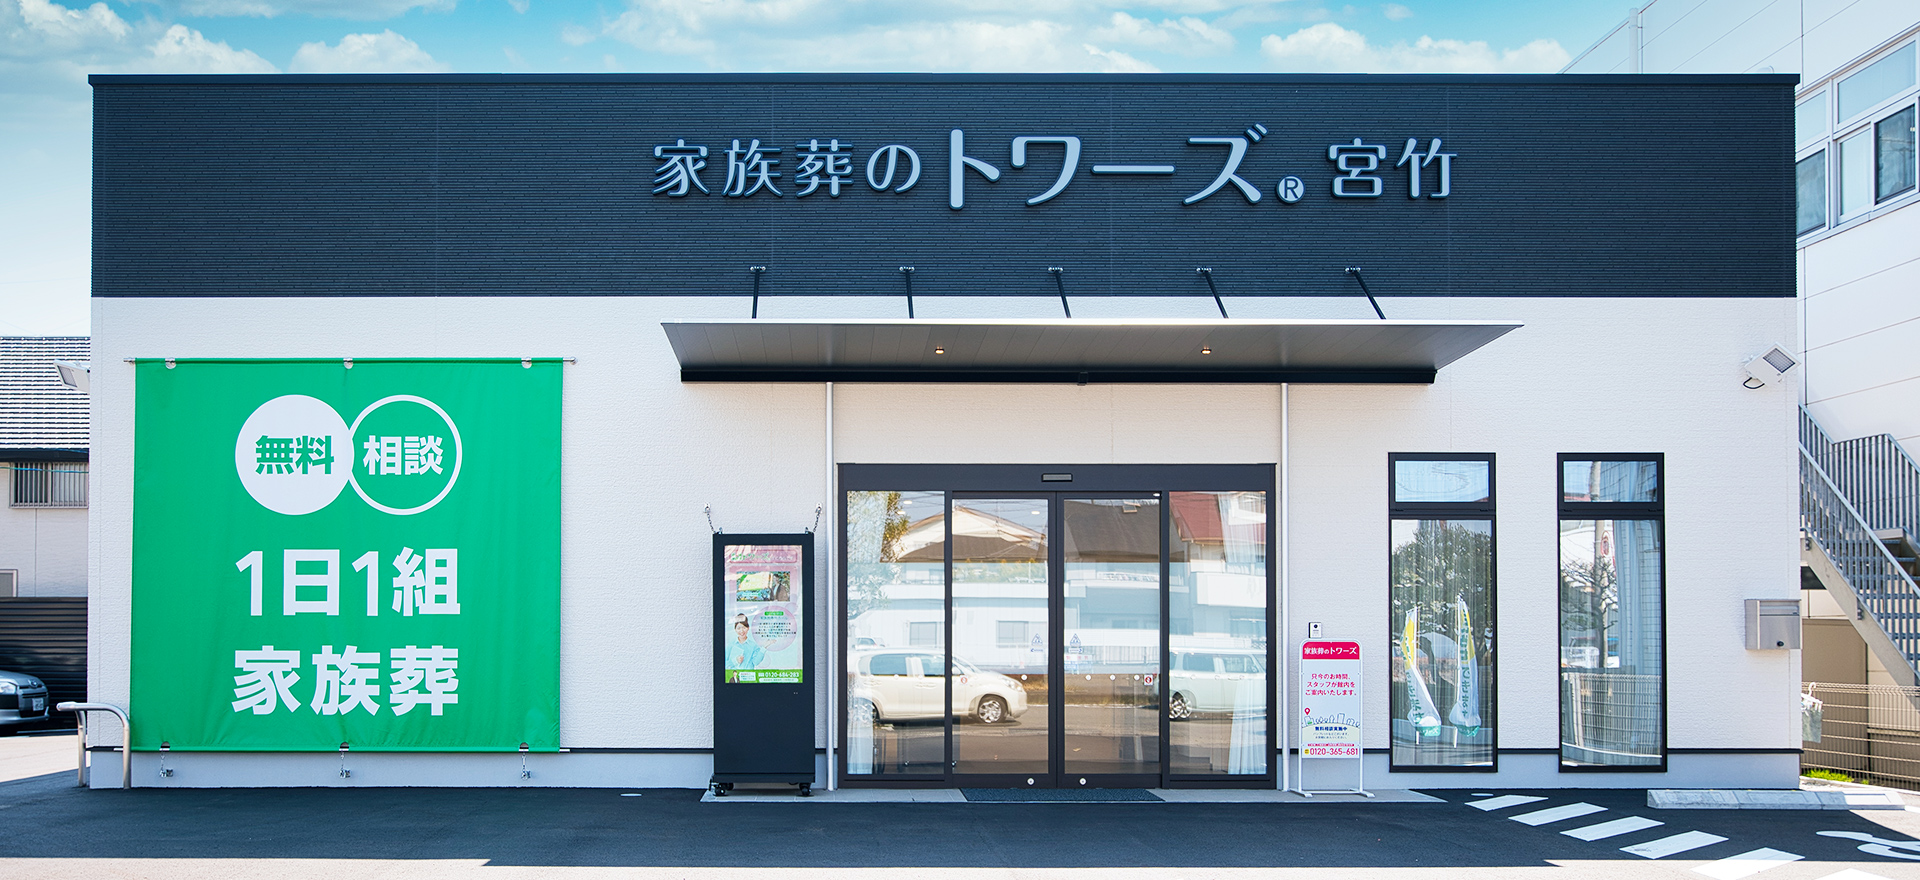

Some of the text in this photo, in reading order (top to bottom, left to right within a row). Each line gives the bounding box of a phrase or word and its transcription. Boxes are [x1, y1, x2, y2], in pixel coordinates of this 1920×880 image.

[1328, 137, 1459, 201] 宮竹
[255, 435, 444, 476] 無料 相談
[235, 546, 461, 617] 1日1組
[1304, 646, 1357, 655] 家族葬のトワーズ
[231, 645, 460, 717] 家族葬
[1309, 748, 1359, 756] 0120-365-681
